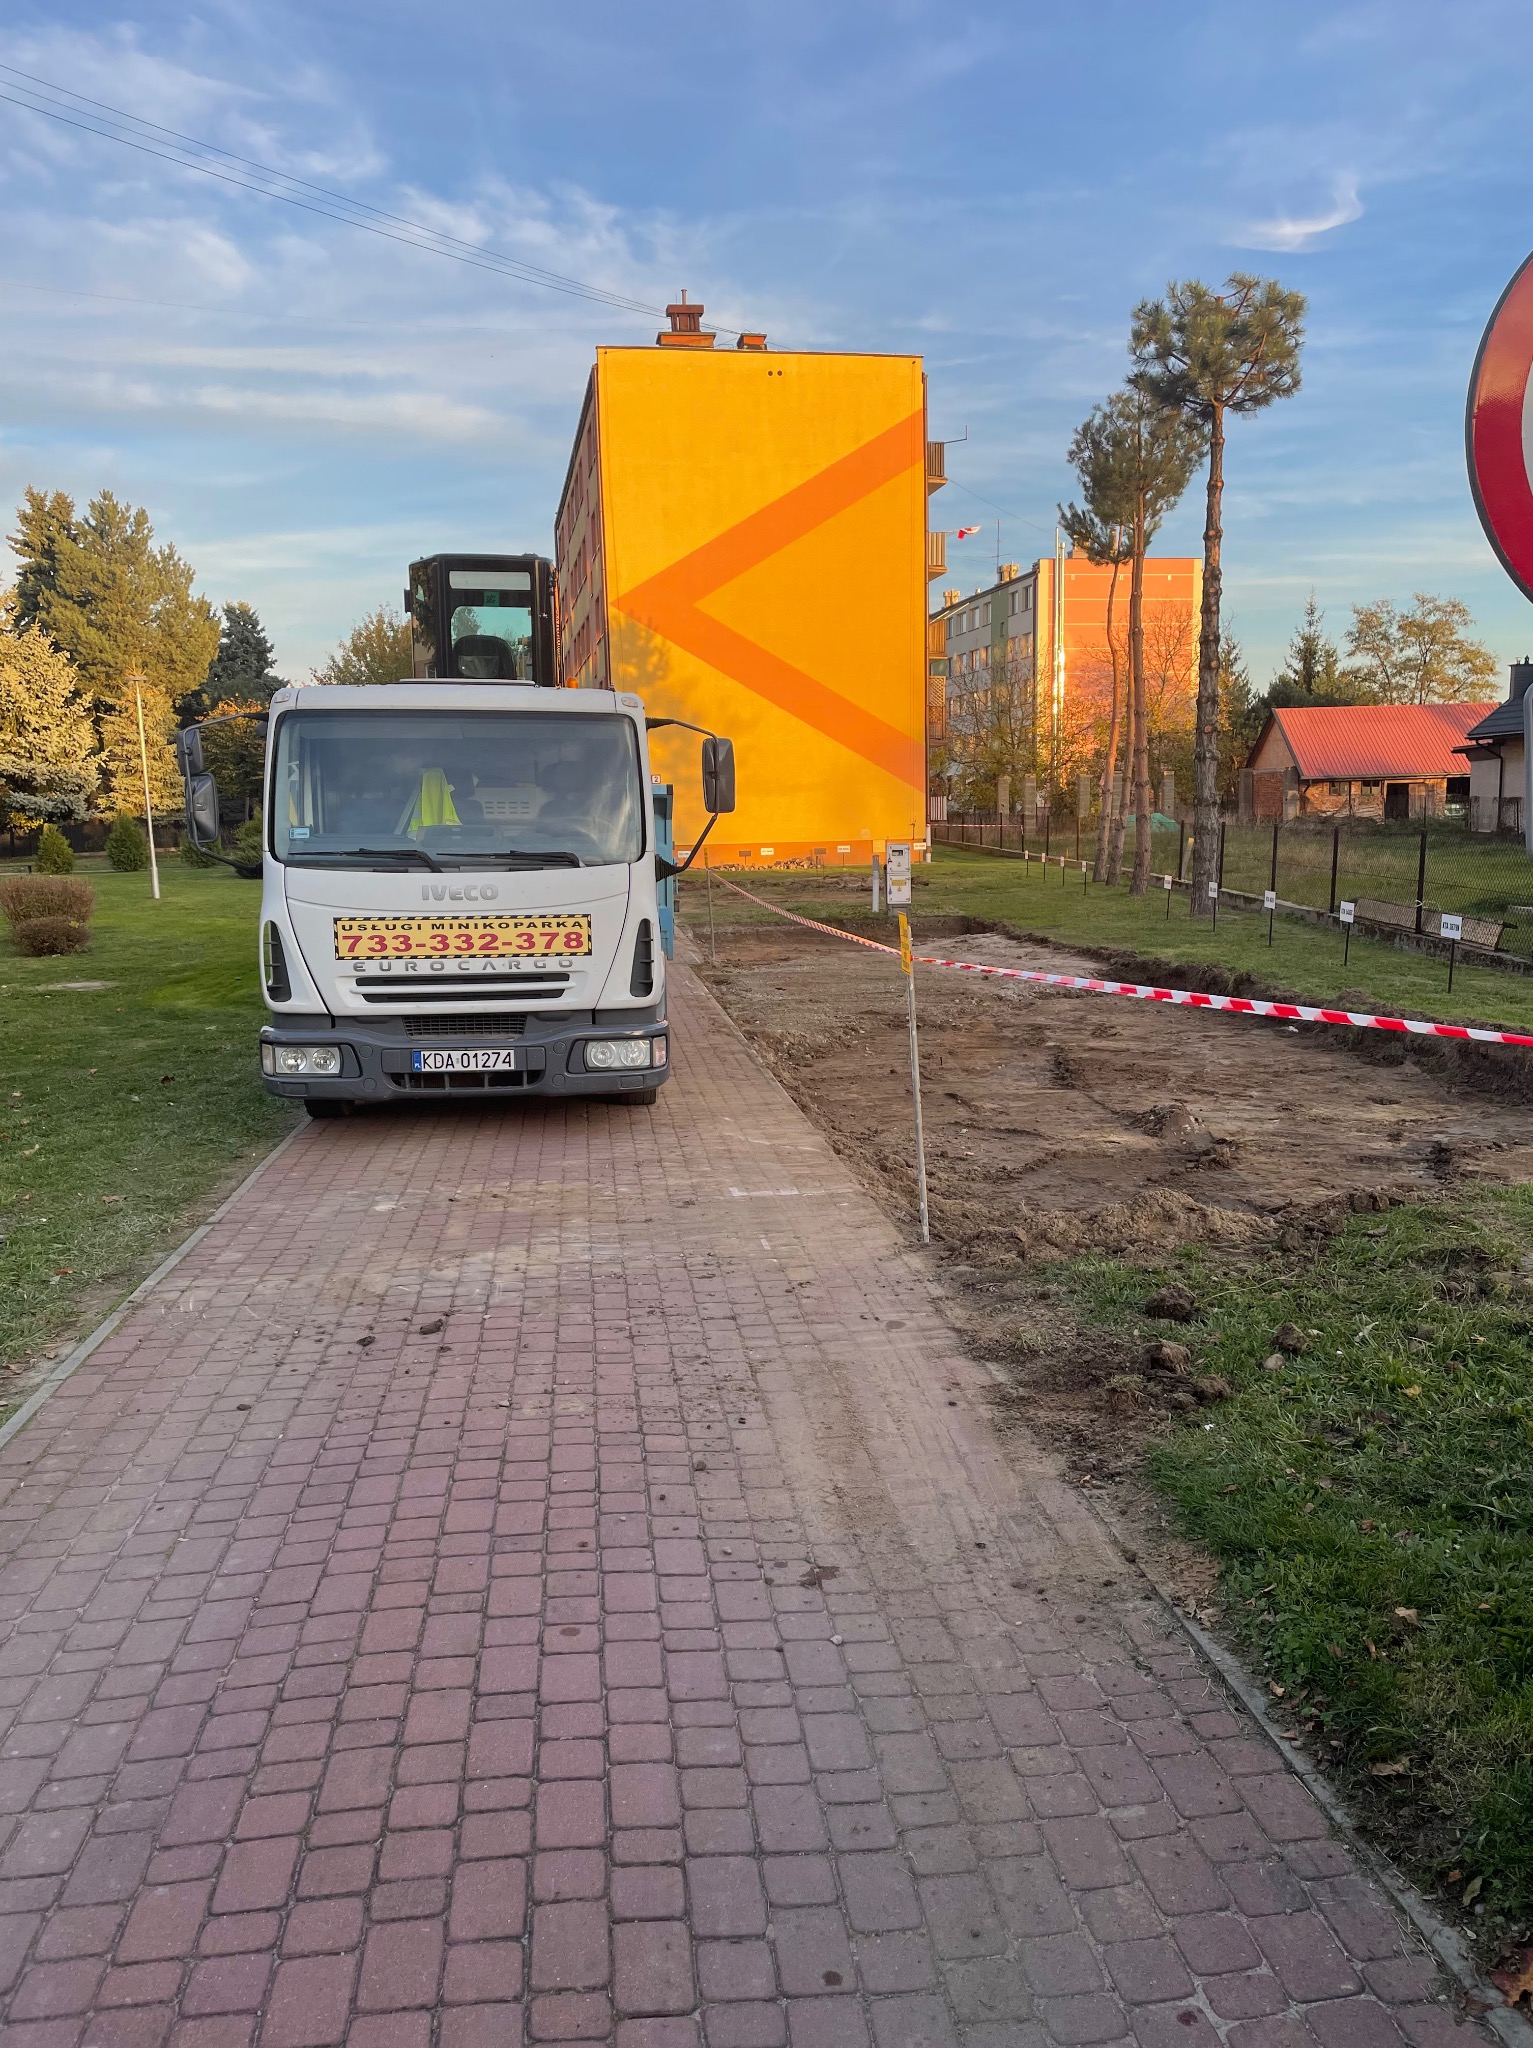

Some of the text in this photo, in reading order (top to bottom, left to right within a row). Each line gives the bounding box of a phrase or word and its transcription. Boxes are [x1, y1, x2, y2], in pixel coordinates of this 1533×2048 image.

[421, 884, 499, 901] IVECO
[341, 921, 584, 931] USŁUGI MINIKOPARKĄ
[341, 931, 584, 953] 733-332-378
[352, 959, 574, 973] EUROCARGO
[422, 1051, 512, 1069] KDA 01274
